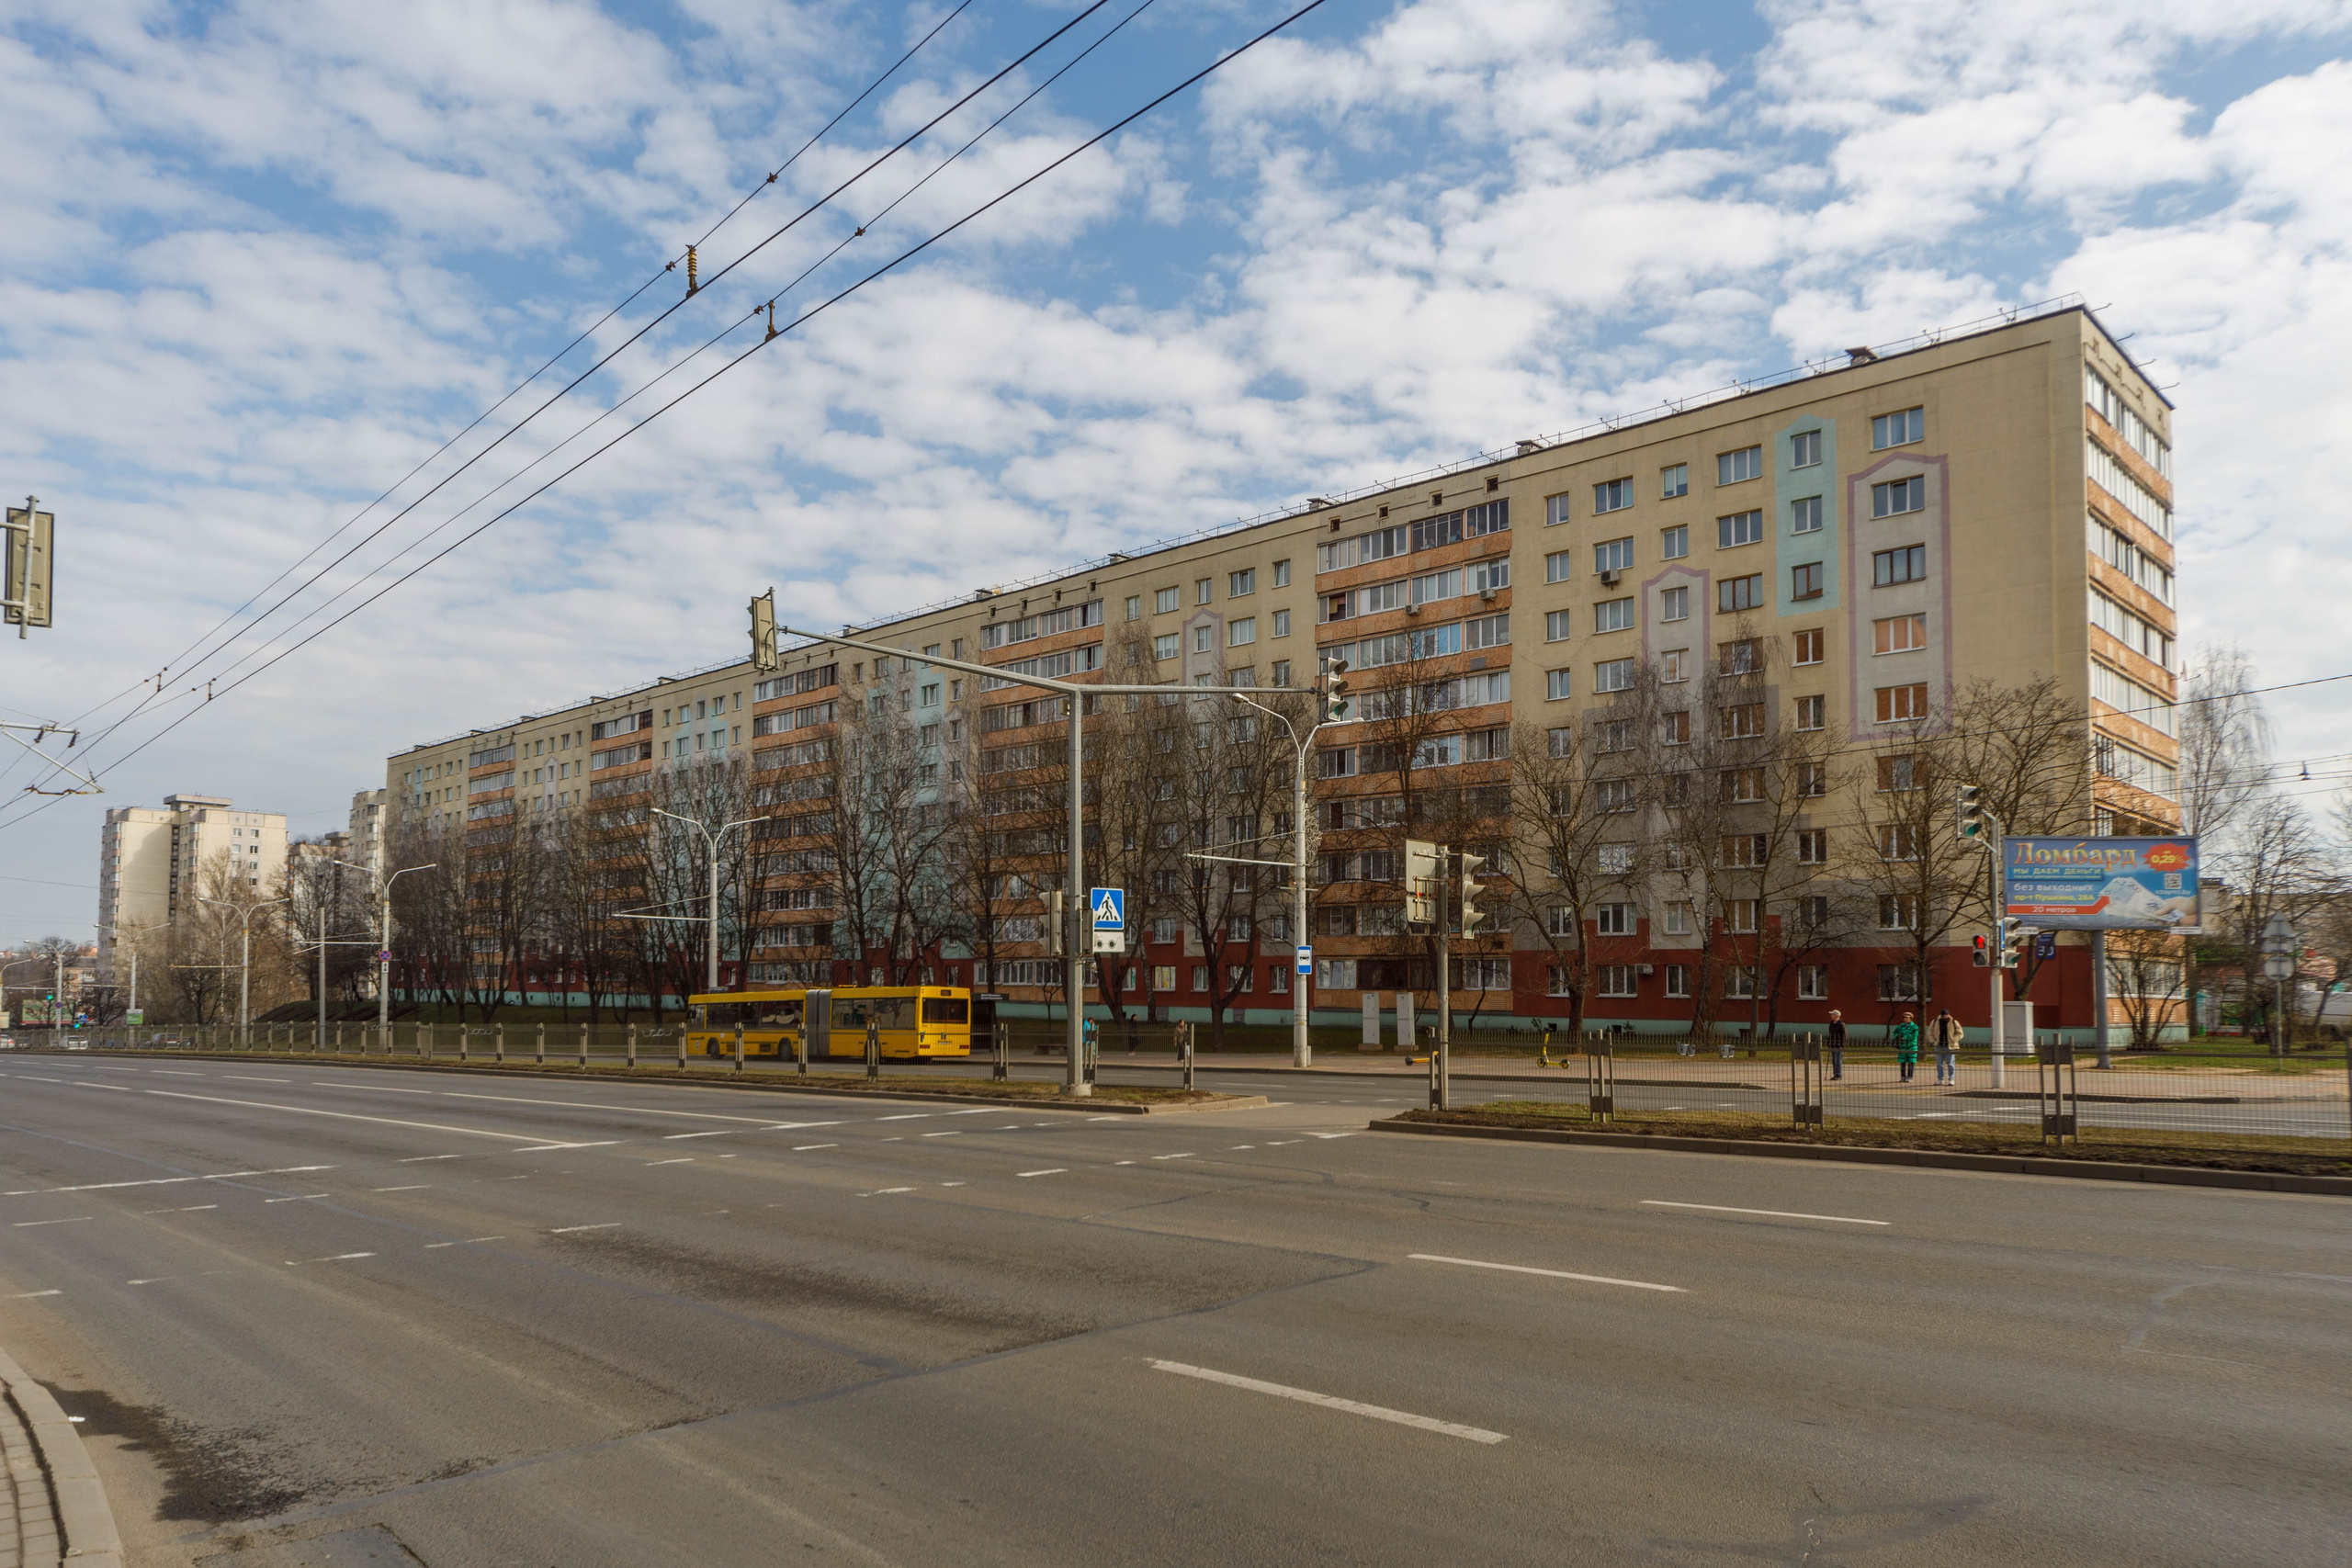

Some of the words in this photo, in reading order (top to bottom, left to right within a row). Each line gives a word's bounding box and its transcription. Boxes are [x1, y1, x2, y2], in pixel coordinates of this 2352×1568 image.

[2014, 841, 2137, 872] Ломбард
[2014, 883, 2034, 891] без
[2037, 884, 2094, 892] выходных
